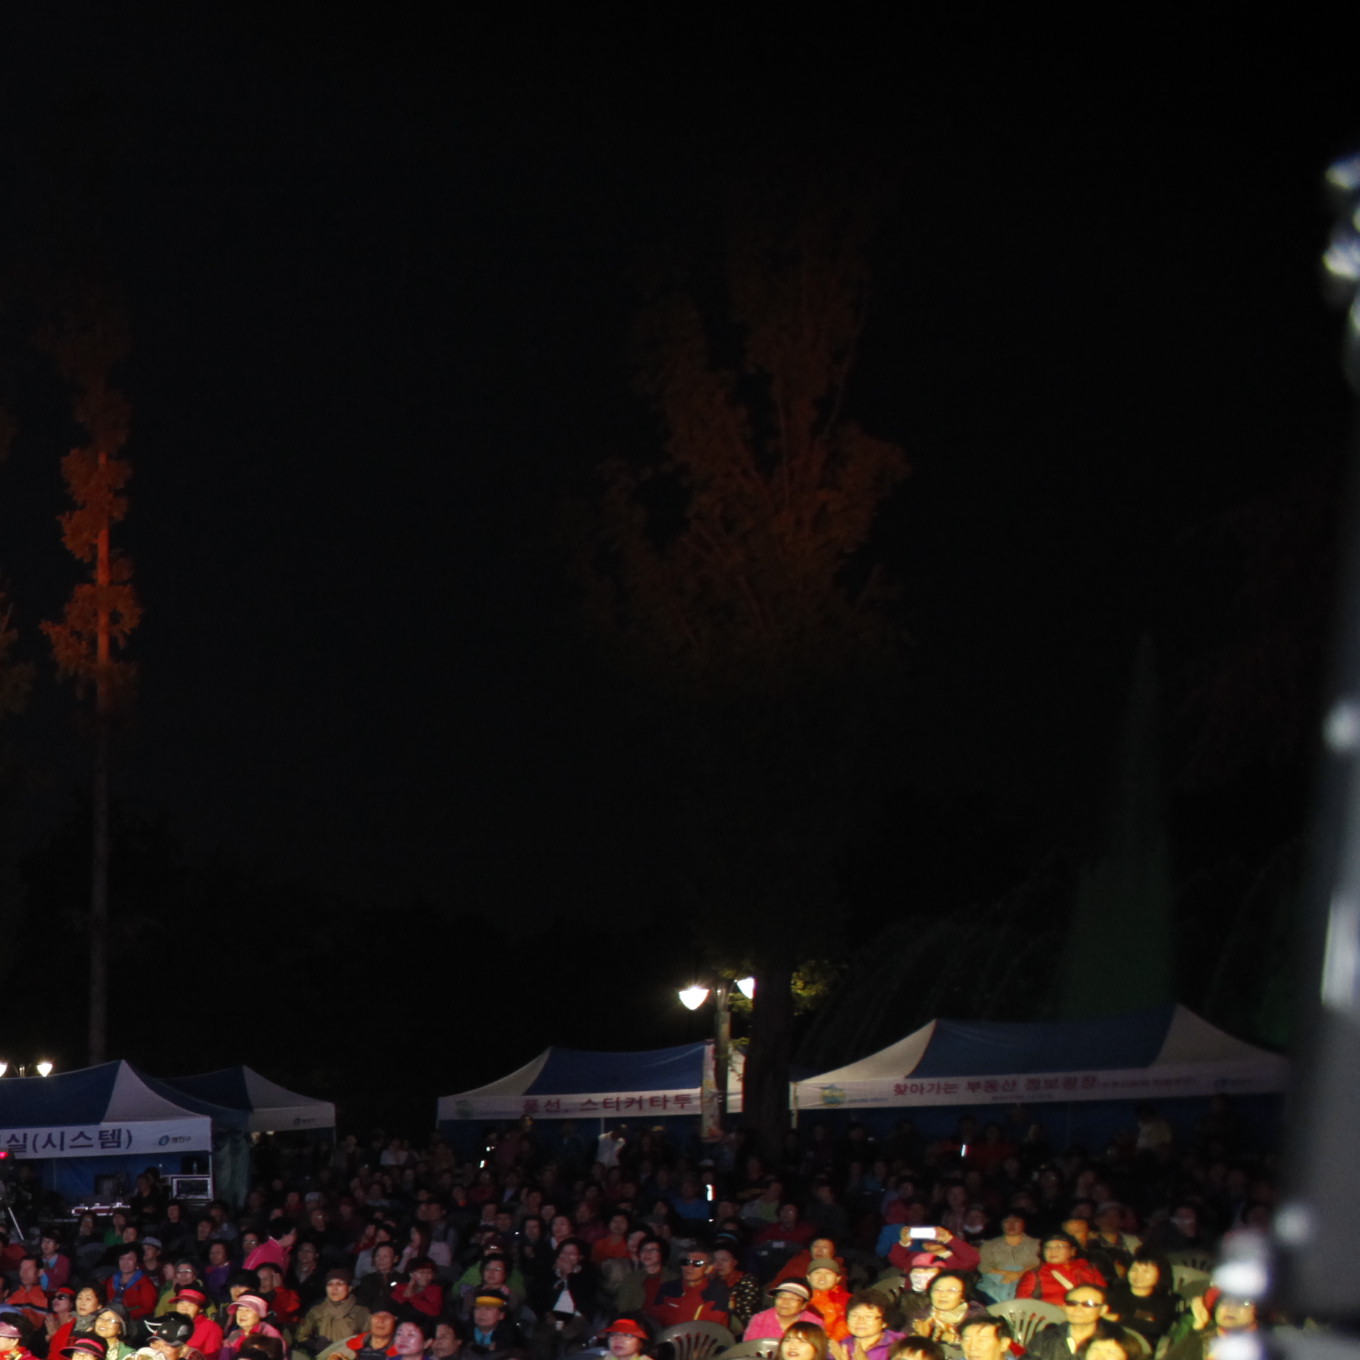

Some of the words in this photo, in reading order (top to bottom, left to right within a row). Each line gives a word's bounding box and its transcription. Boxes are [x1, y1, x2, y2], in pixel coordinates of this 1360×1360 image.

[894, 1082, 958, 1096] 찾아가는
[965, 1079, 1017, 1094] 부동산
[580, 1094, 693, 1112] 스티커타투
